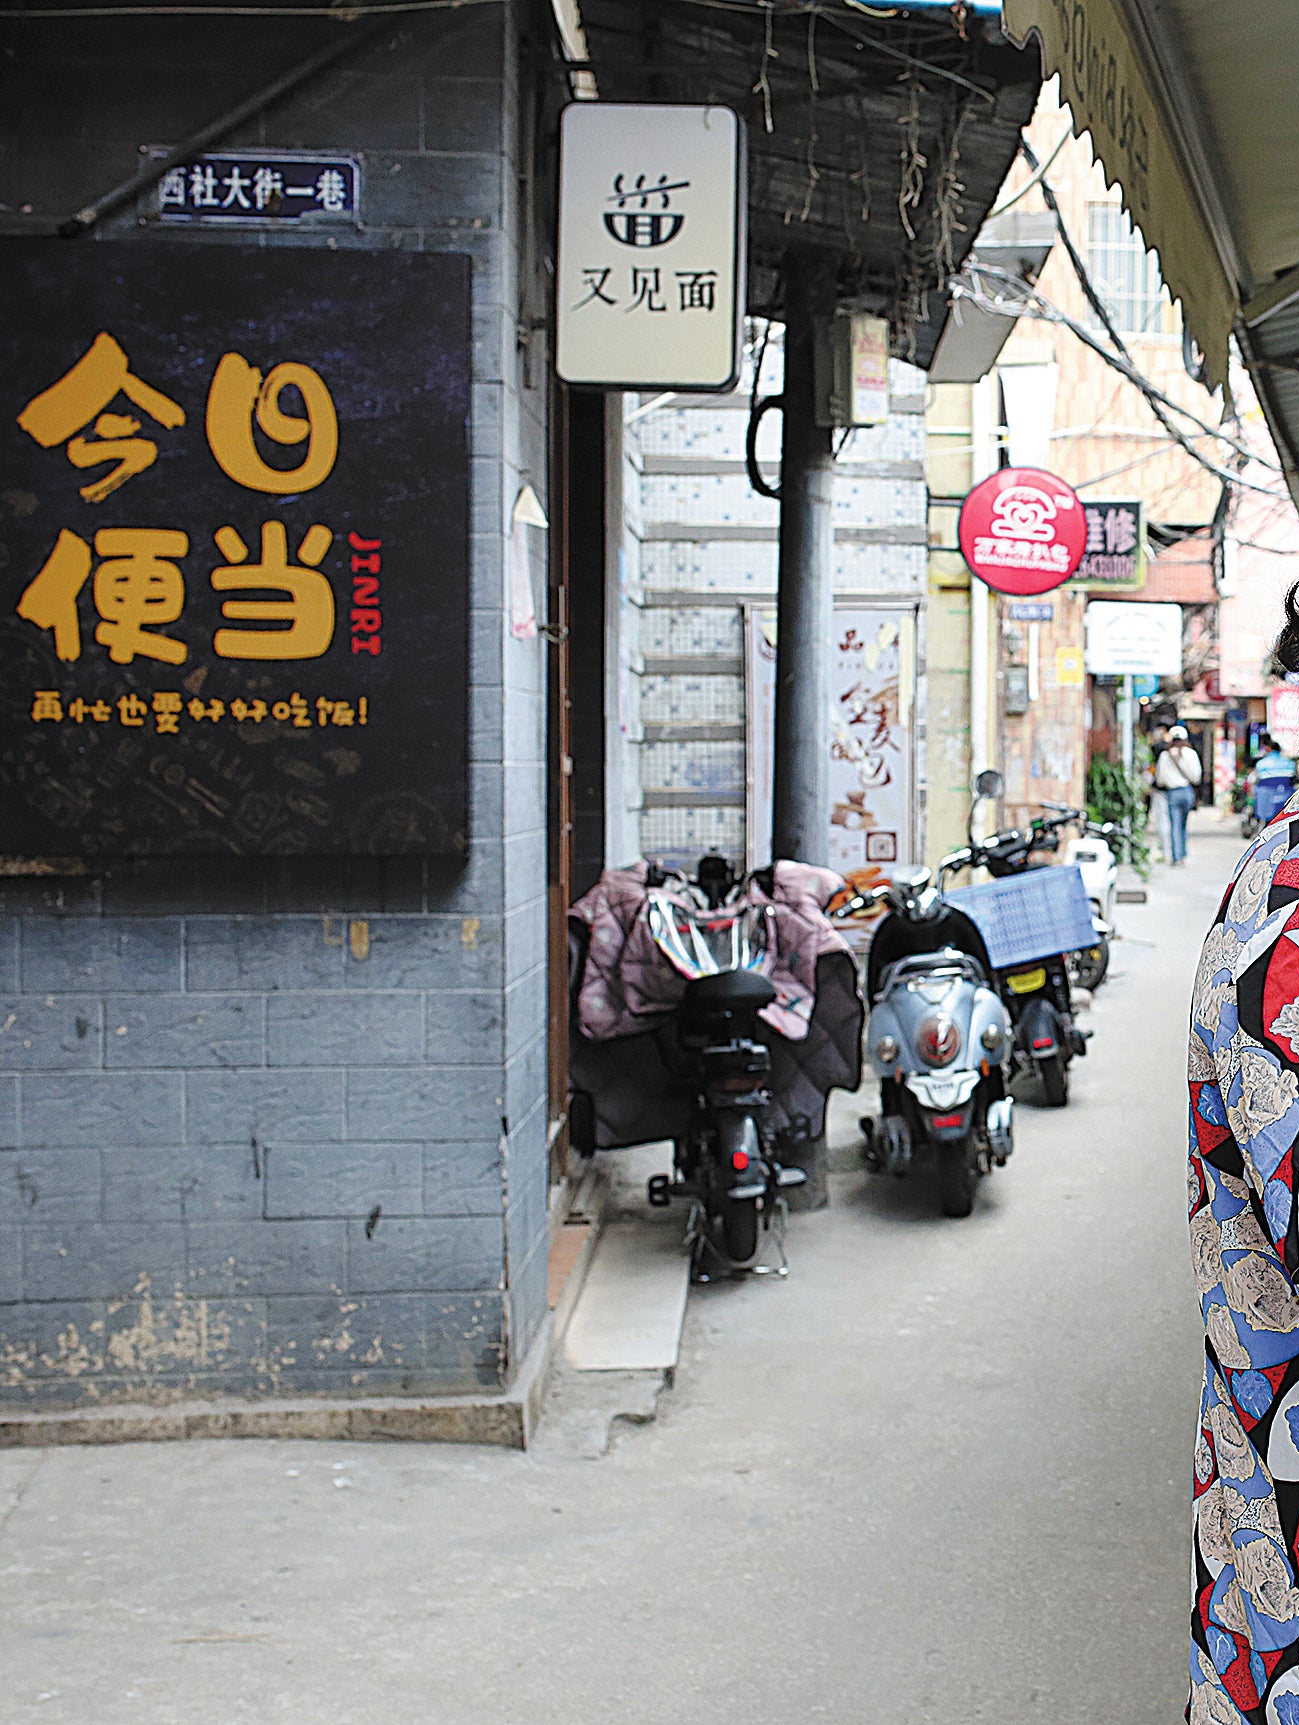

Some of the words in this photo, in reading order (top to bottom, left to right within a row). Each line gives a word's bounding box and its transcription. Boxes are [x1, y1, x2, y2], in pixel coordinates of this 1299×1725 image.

[159, 164, 347, 211] 西社大街一巷
[571, 267, 719, 314] 又见面
[17, 331, 338, 502] 今日
[17, 520, 335, 665] 便当
[349, 532, 382, 656] JINRI
[31, 690, 367, 734] 再忙也要好好吃饭!
